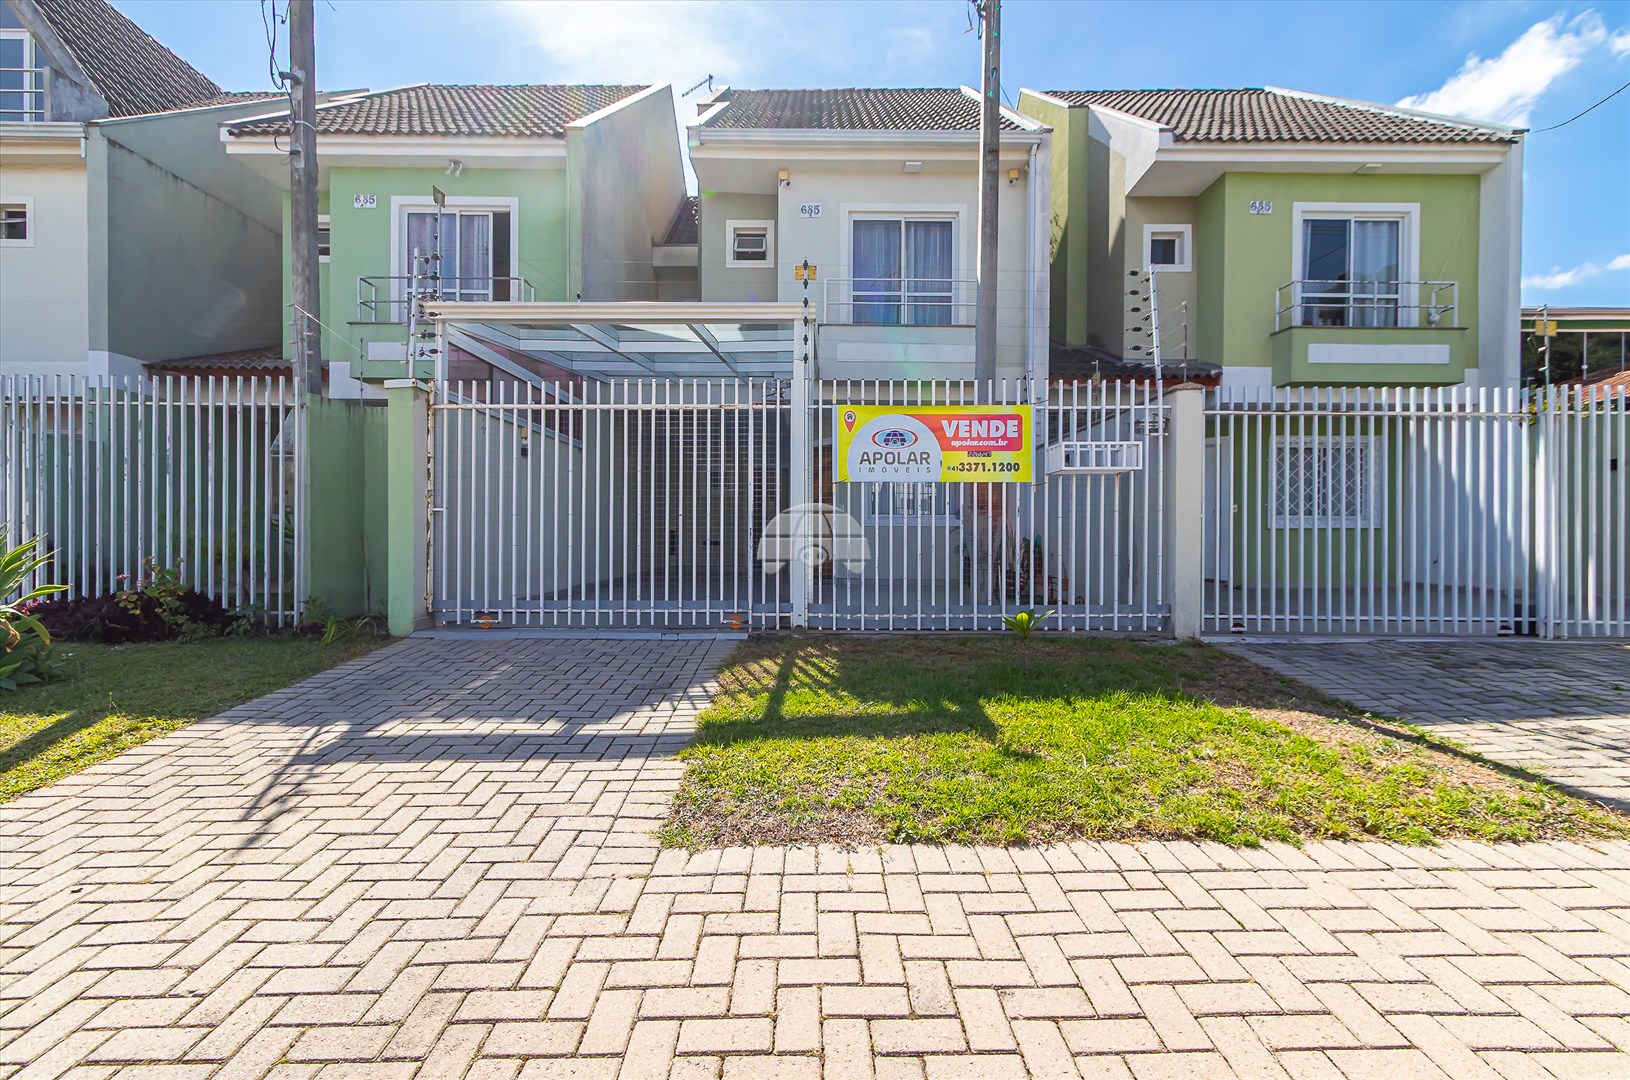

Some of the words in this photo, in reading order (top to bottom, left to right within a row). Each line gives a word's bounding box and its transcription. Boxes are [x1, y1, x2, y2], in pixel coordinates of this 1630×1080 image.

[801, 204, 820, 215] 685
[941, 419, 1019, 438] VENDE
[951, 439, 1008, 447] apolar.com.br
[860, 451, 931, 465] APOLAR
[958, 462, 1021, 472] 3371.1200
